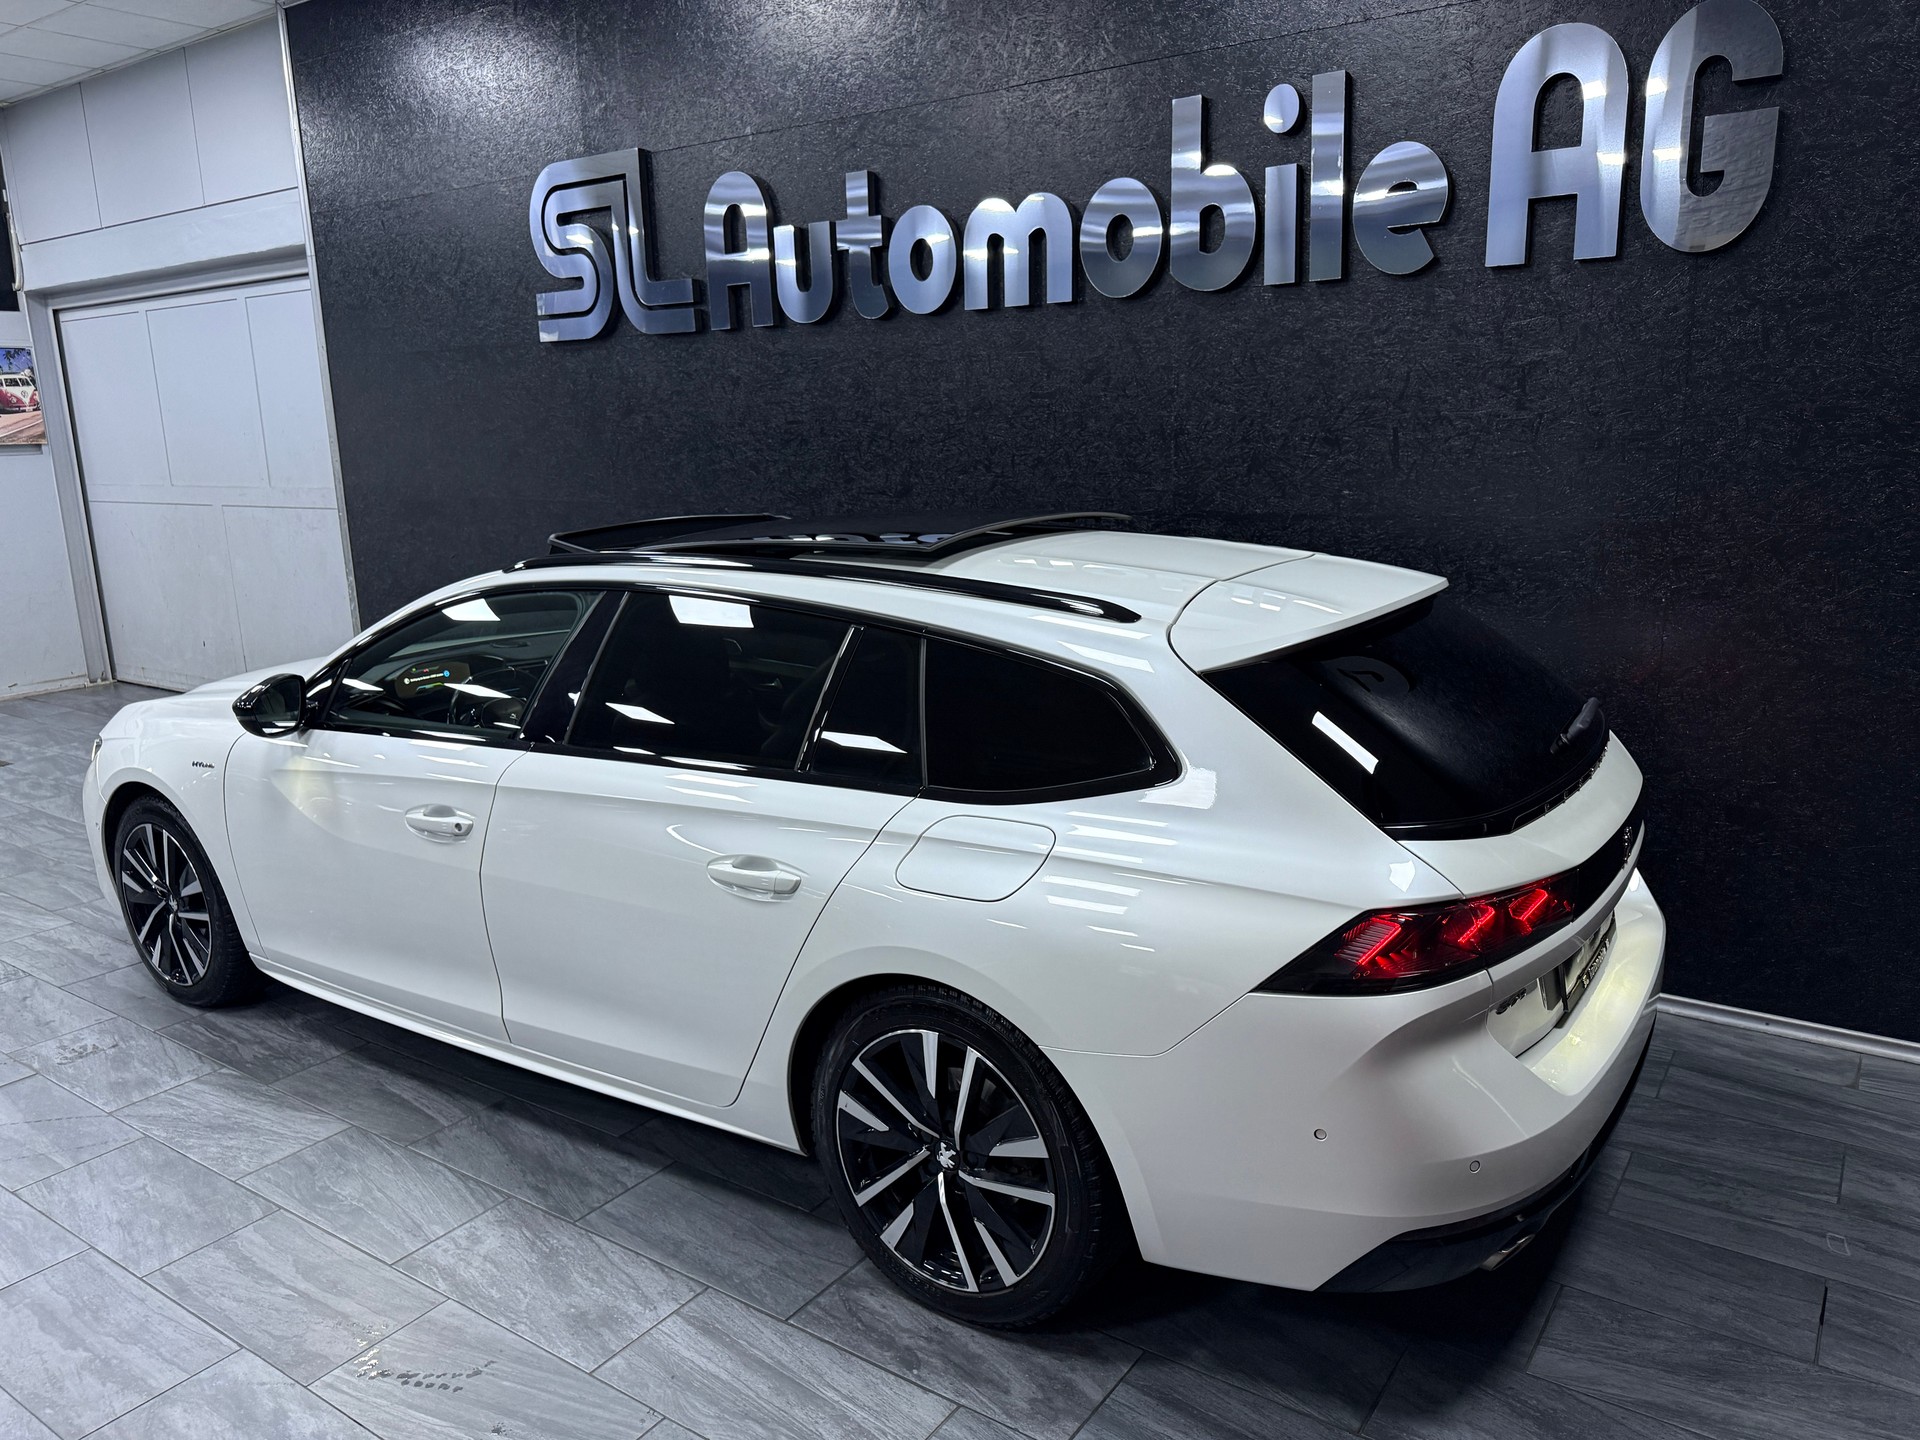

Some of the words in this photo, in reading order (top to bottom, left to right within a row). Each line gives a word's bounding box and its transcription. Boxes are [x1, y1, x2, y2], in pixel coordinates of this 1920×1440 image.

[529, 147, 697, 342] SL
[703, 70, 1449, 331] Automobile
[1485, 0, 1784, 267] AG
